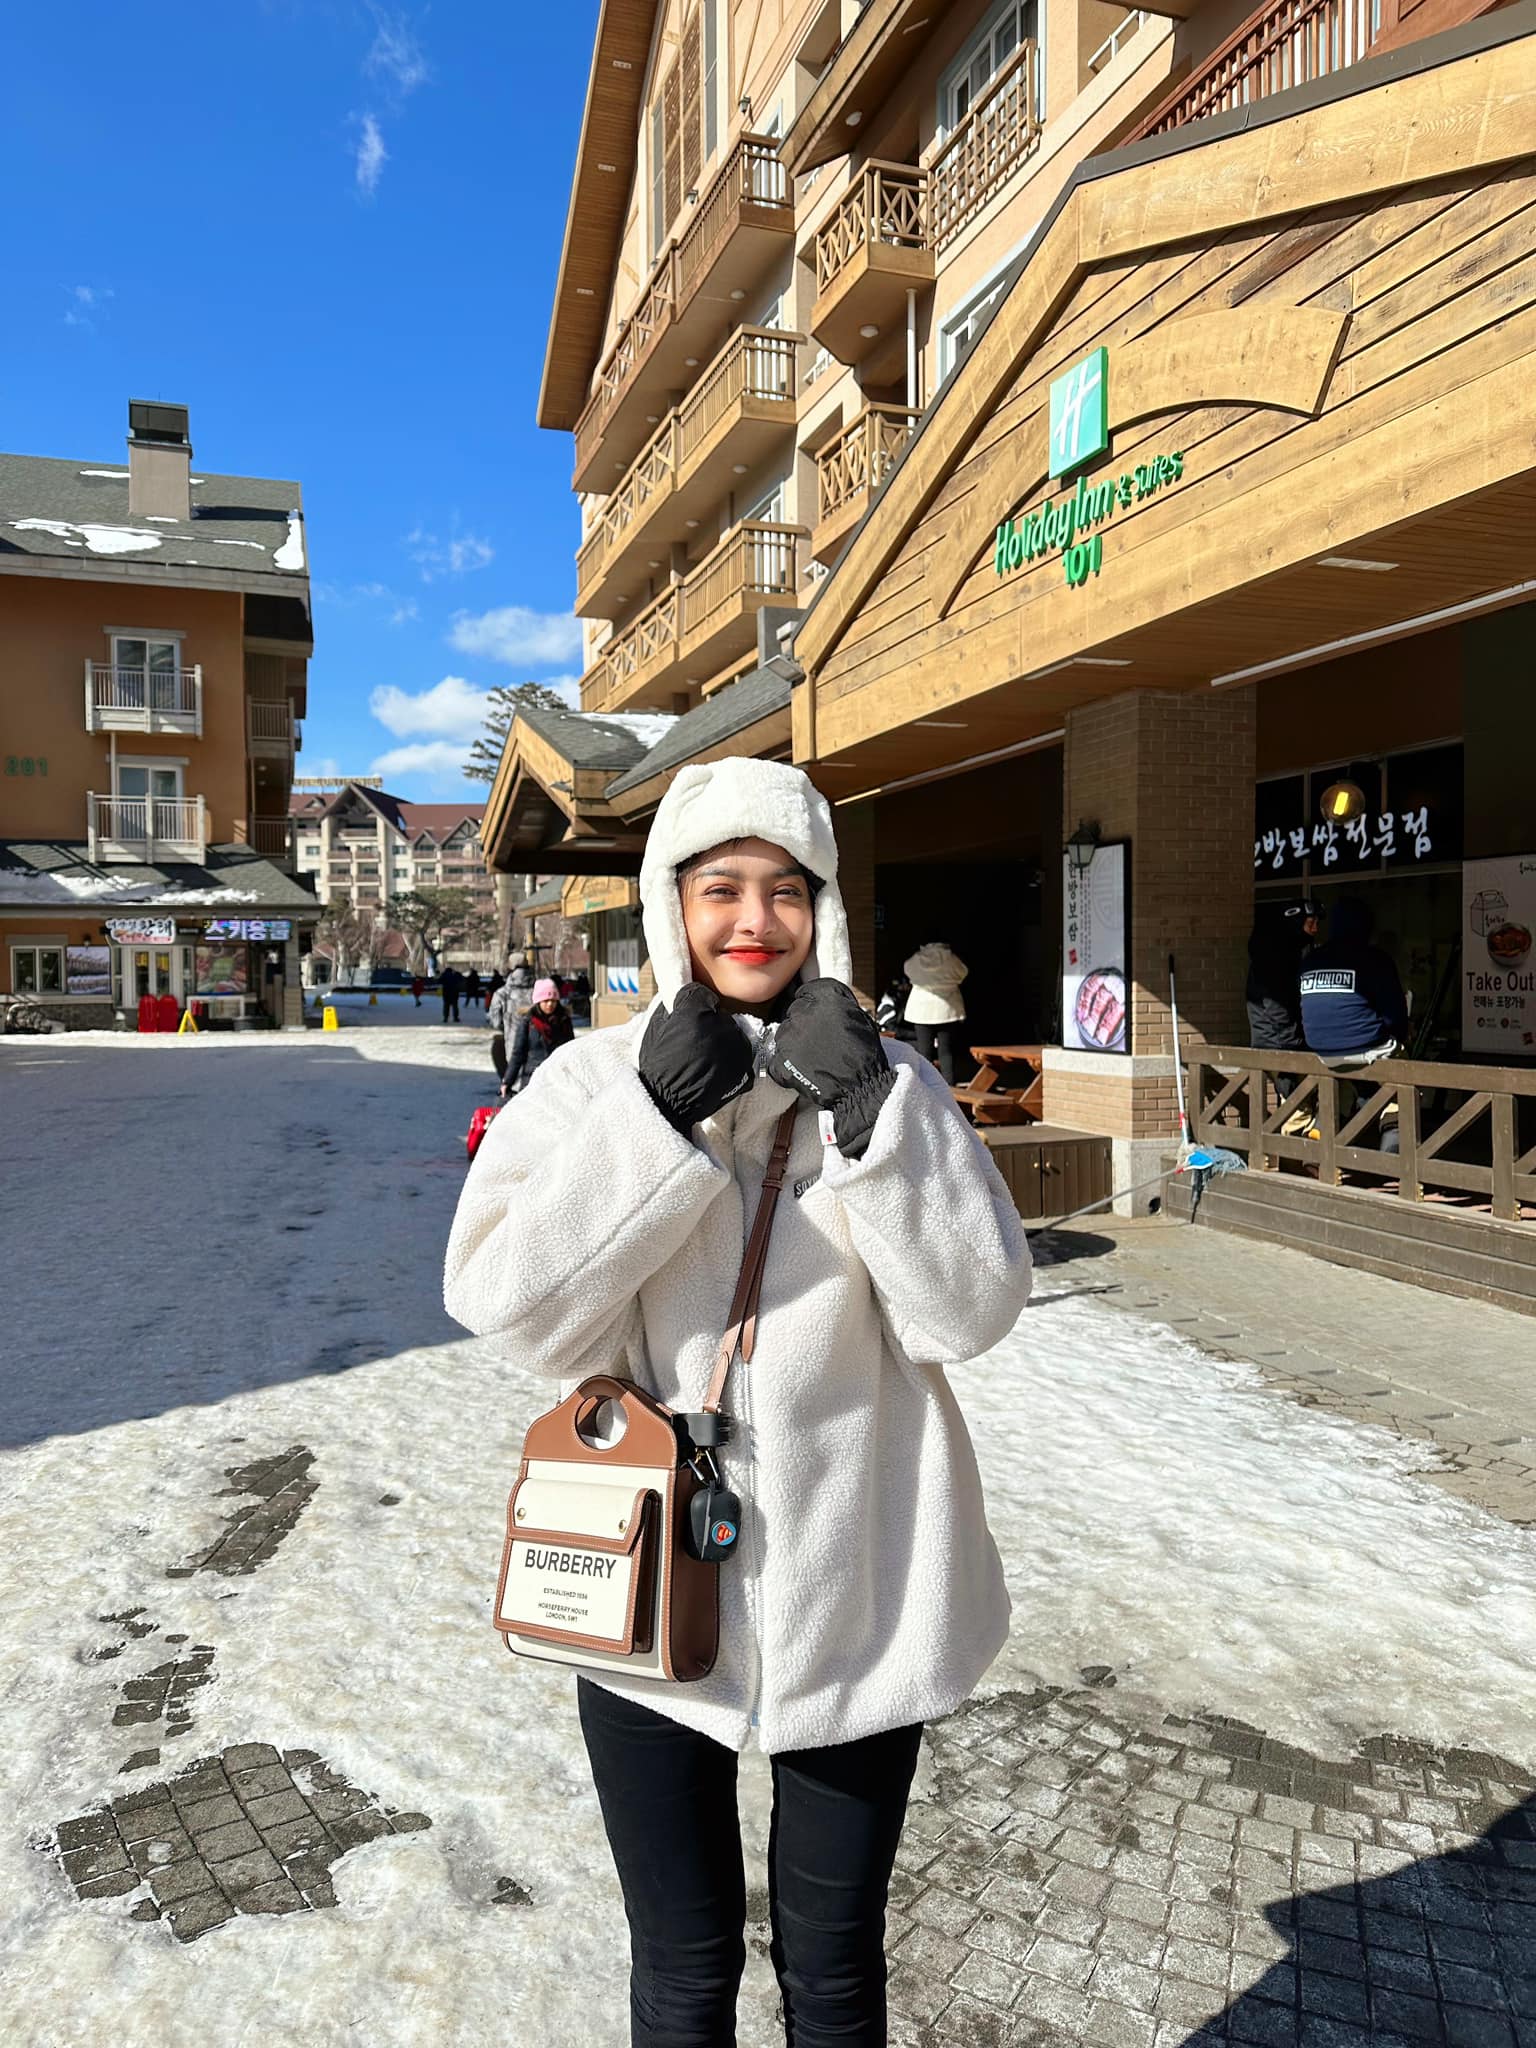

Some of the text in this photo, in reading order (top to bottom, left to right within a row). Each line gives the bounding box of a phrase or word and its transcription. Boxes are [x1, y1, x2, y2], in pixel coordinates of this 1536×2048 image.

[995, 499, 1076, 574] Holiday
[1074, 476, 1115, 529] Inn
[1116, 474, 1132, 505] &
[1062, 535, 1103, 585] 101
[5, 755, 48, 777] 201
[1317, 973, 1351, 985] UNION
[1466, 971, 1534, 991] Take Out
[525, 1548, 617, 1579] BURBERRY
[571, 1607, 589, 1616] HOUSE
